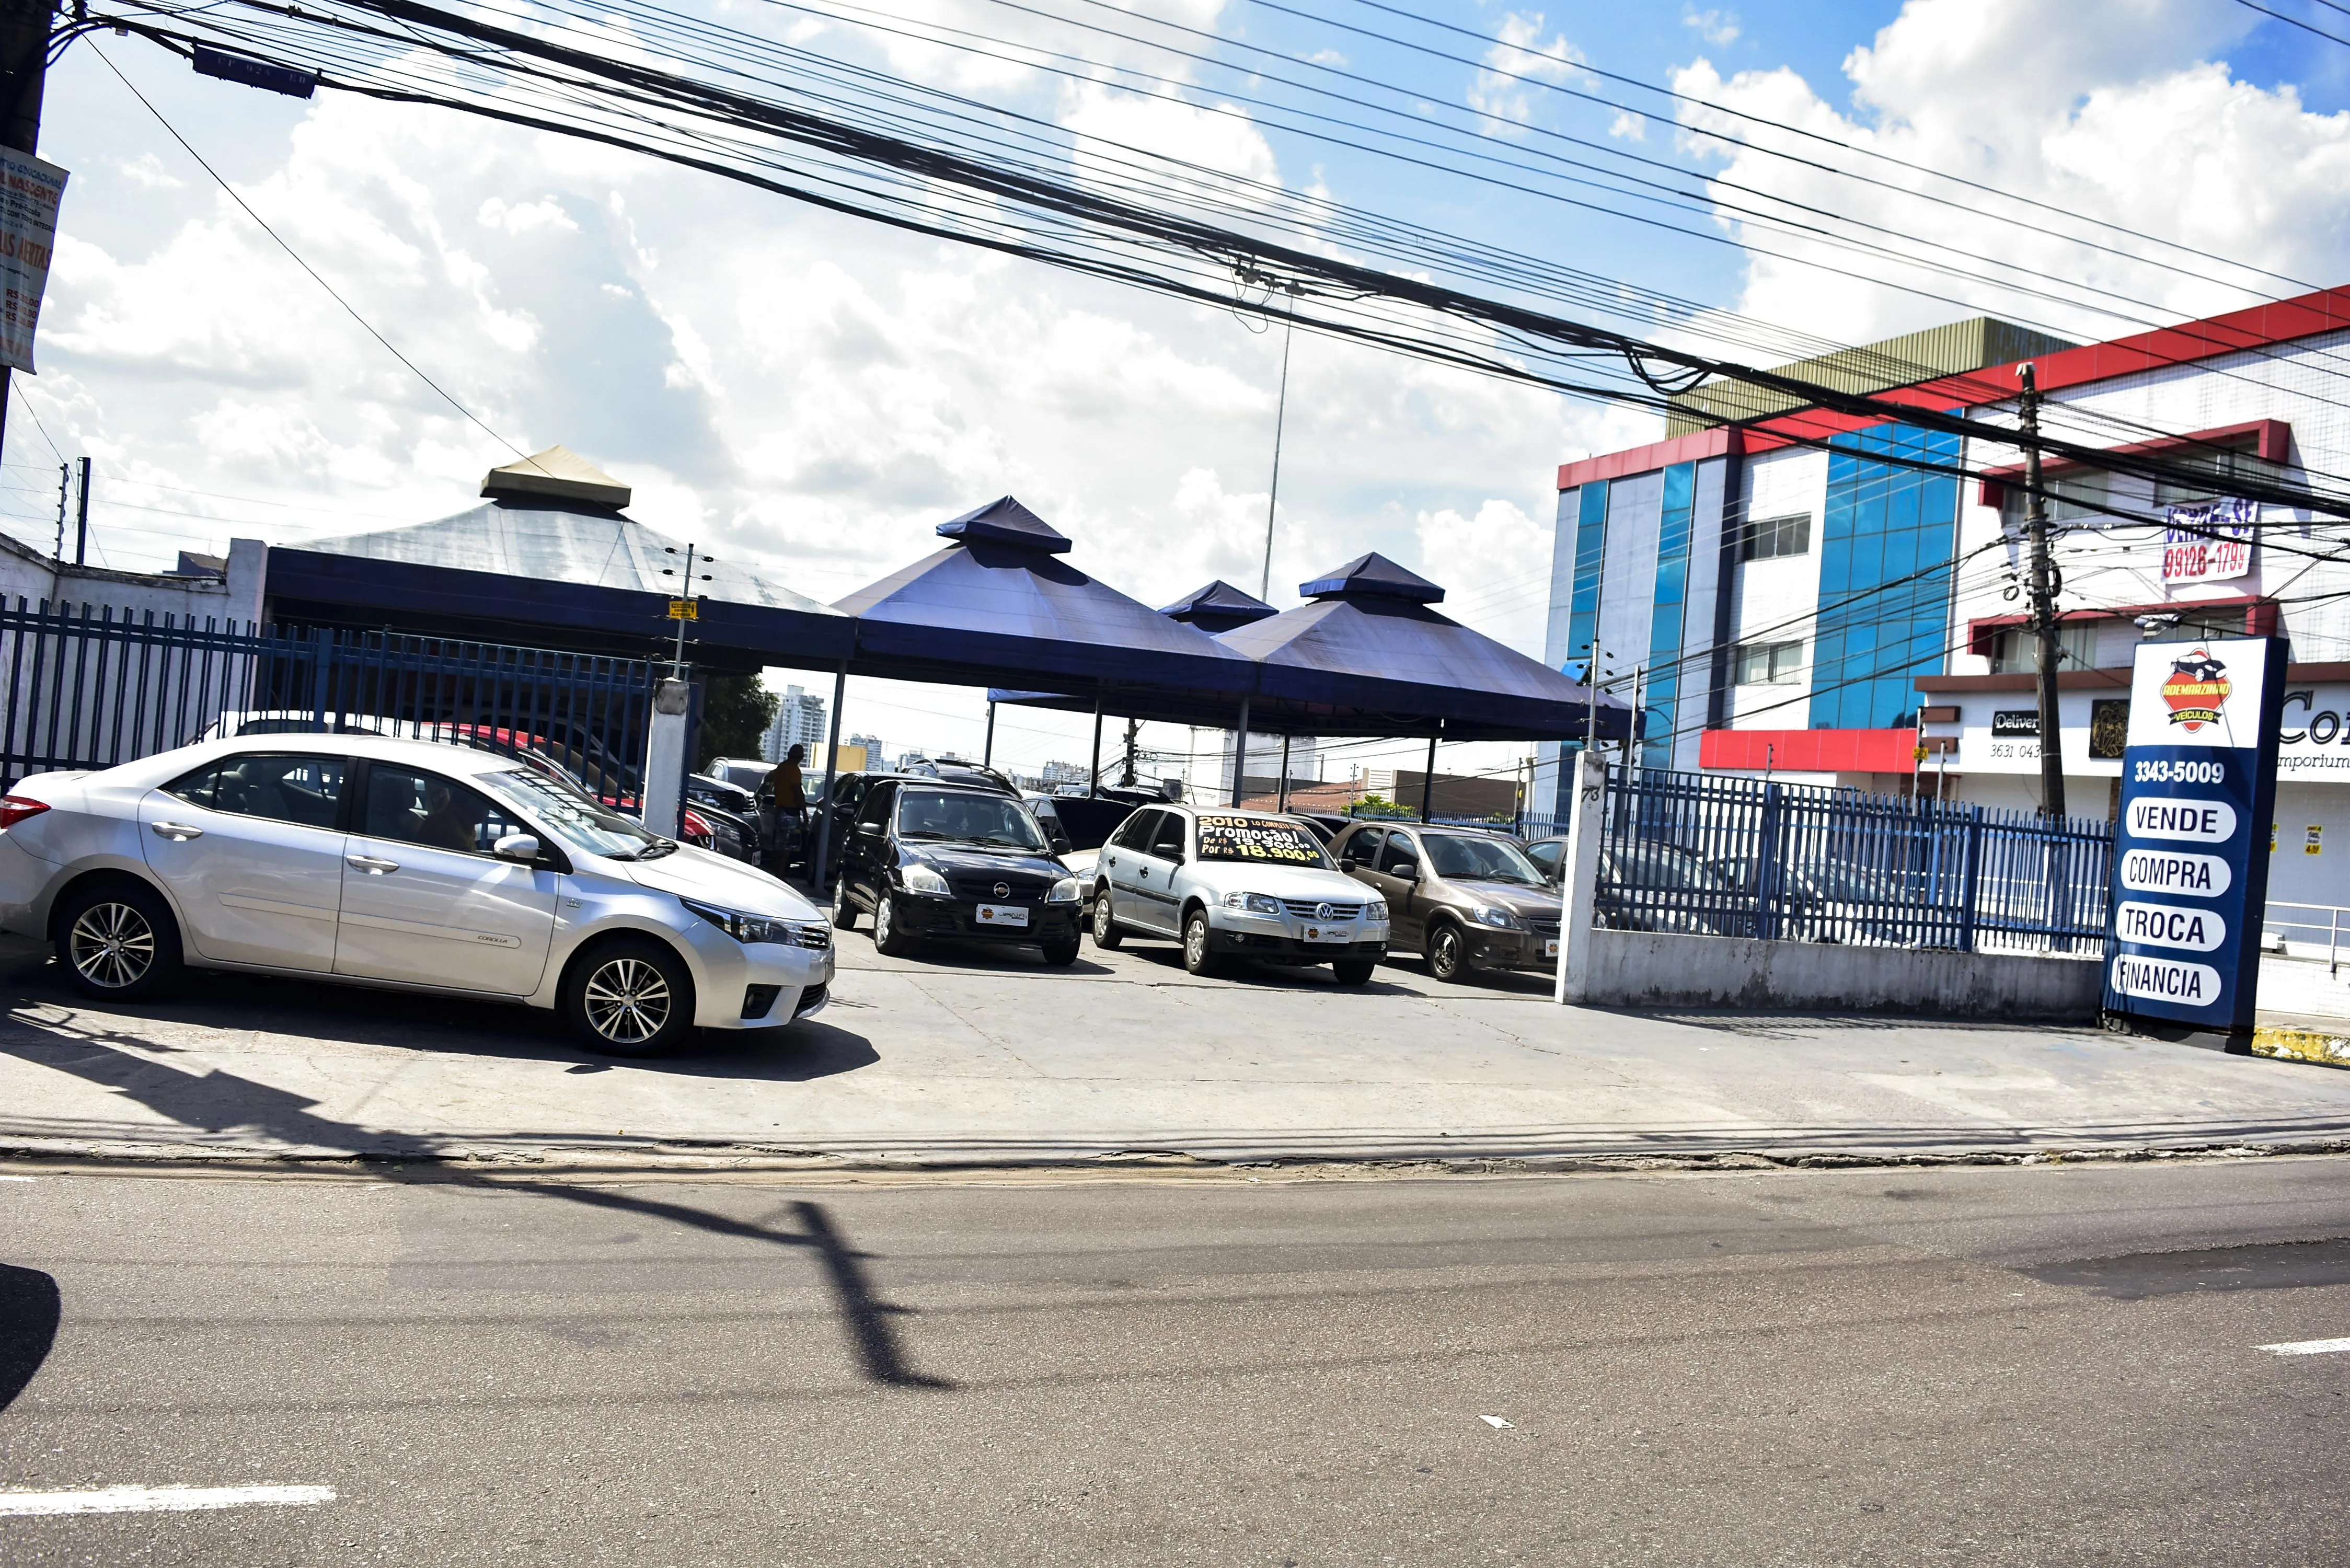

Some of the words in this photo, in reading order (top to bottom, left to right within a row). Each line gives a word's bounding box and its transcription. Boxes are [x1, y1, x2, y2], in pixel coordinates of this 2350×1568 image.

[1995, 714, 2041, 733] Deliver
[1990, 744, 2013, 757] 3631
[2019, 744, 2042, 758] 043
[2135, 760, 2225, 784] 3343-5009
[2277, 754, 2350, 771] mporium
[1199, 816, 1248, 827] 2010
[2136, 806, 2218, 834] VENDE
[1199, 825, 1299, 843] Promoção!
[1202, 844, 1220, 854] Por
[2129, 856, 2211, 890] COMPRA
[2126, 908, 2205, 944] TROCA
[2119, 961, 2201, 998] FINANCIA
